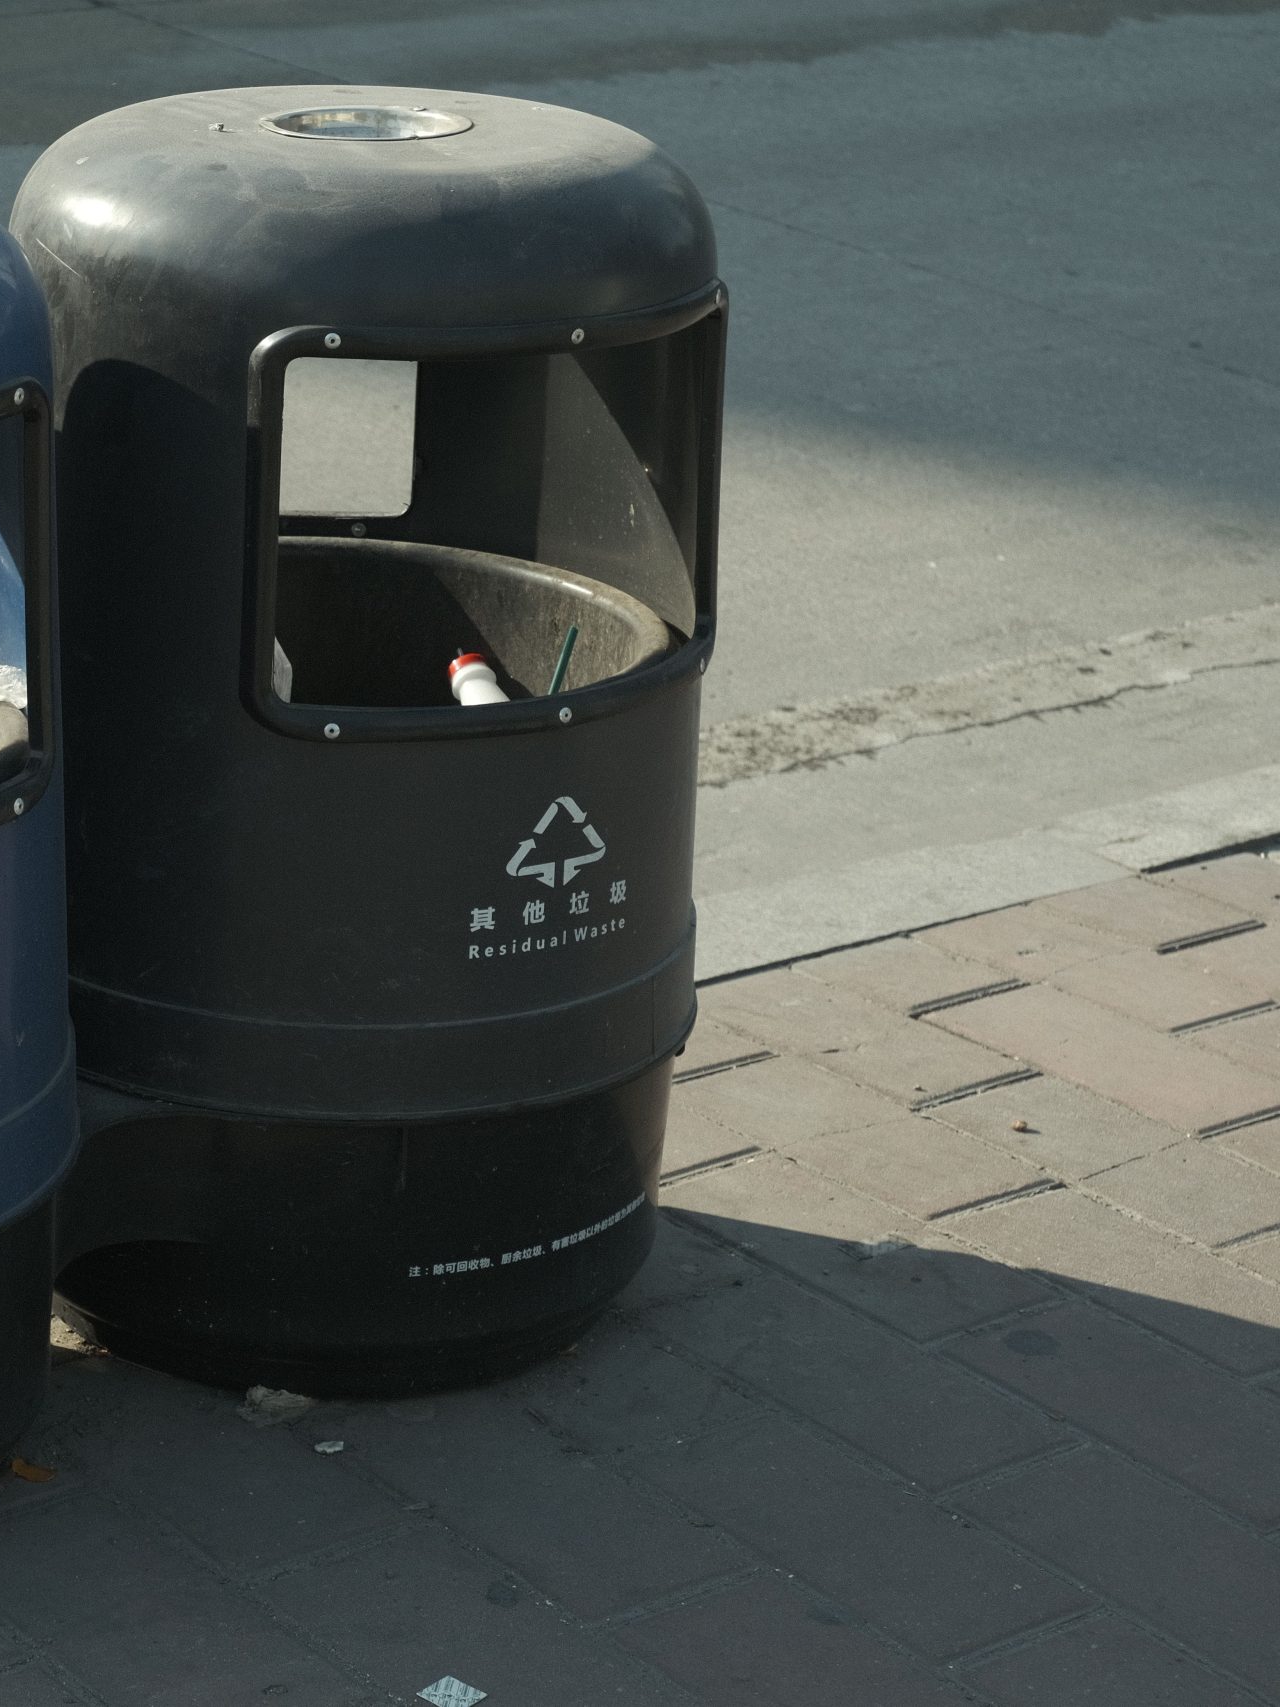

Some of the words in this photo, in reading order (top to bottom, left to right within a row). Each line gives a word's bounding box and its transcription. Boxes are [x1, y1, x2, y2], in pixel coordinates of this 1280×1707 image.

[470, 880, 627, 933] 其他垃圾
[468, 930, 567, 960] Residual
[574, 917, 626, 942] Waste
